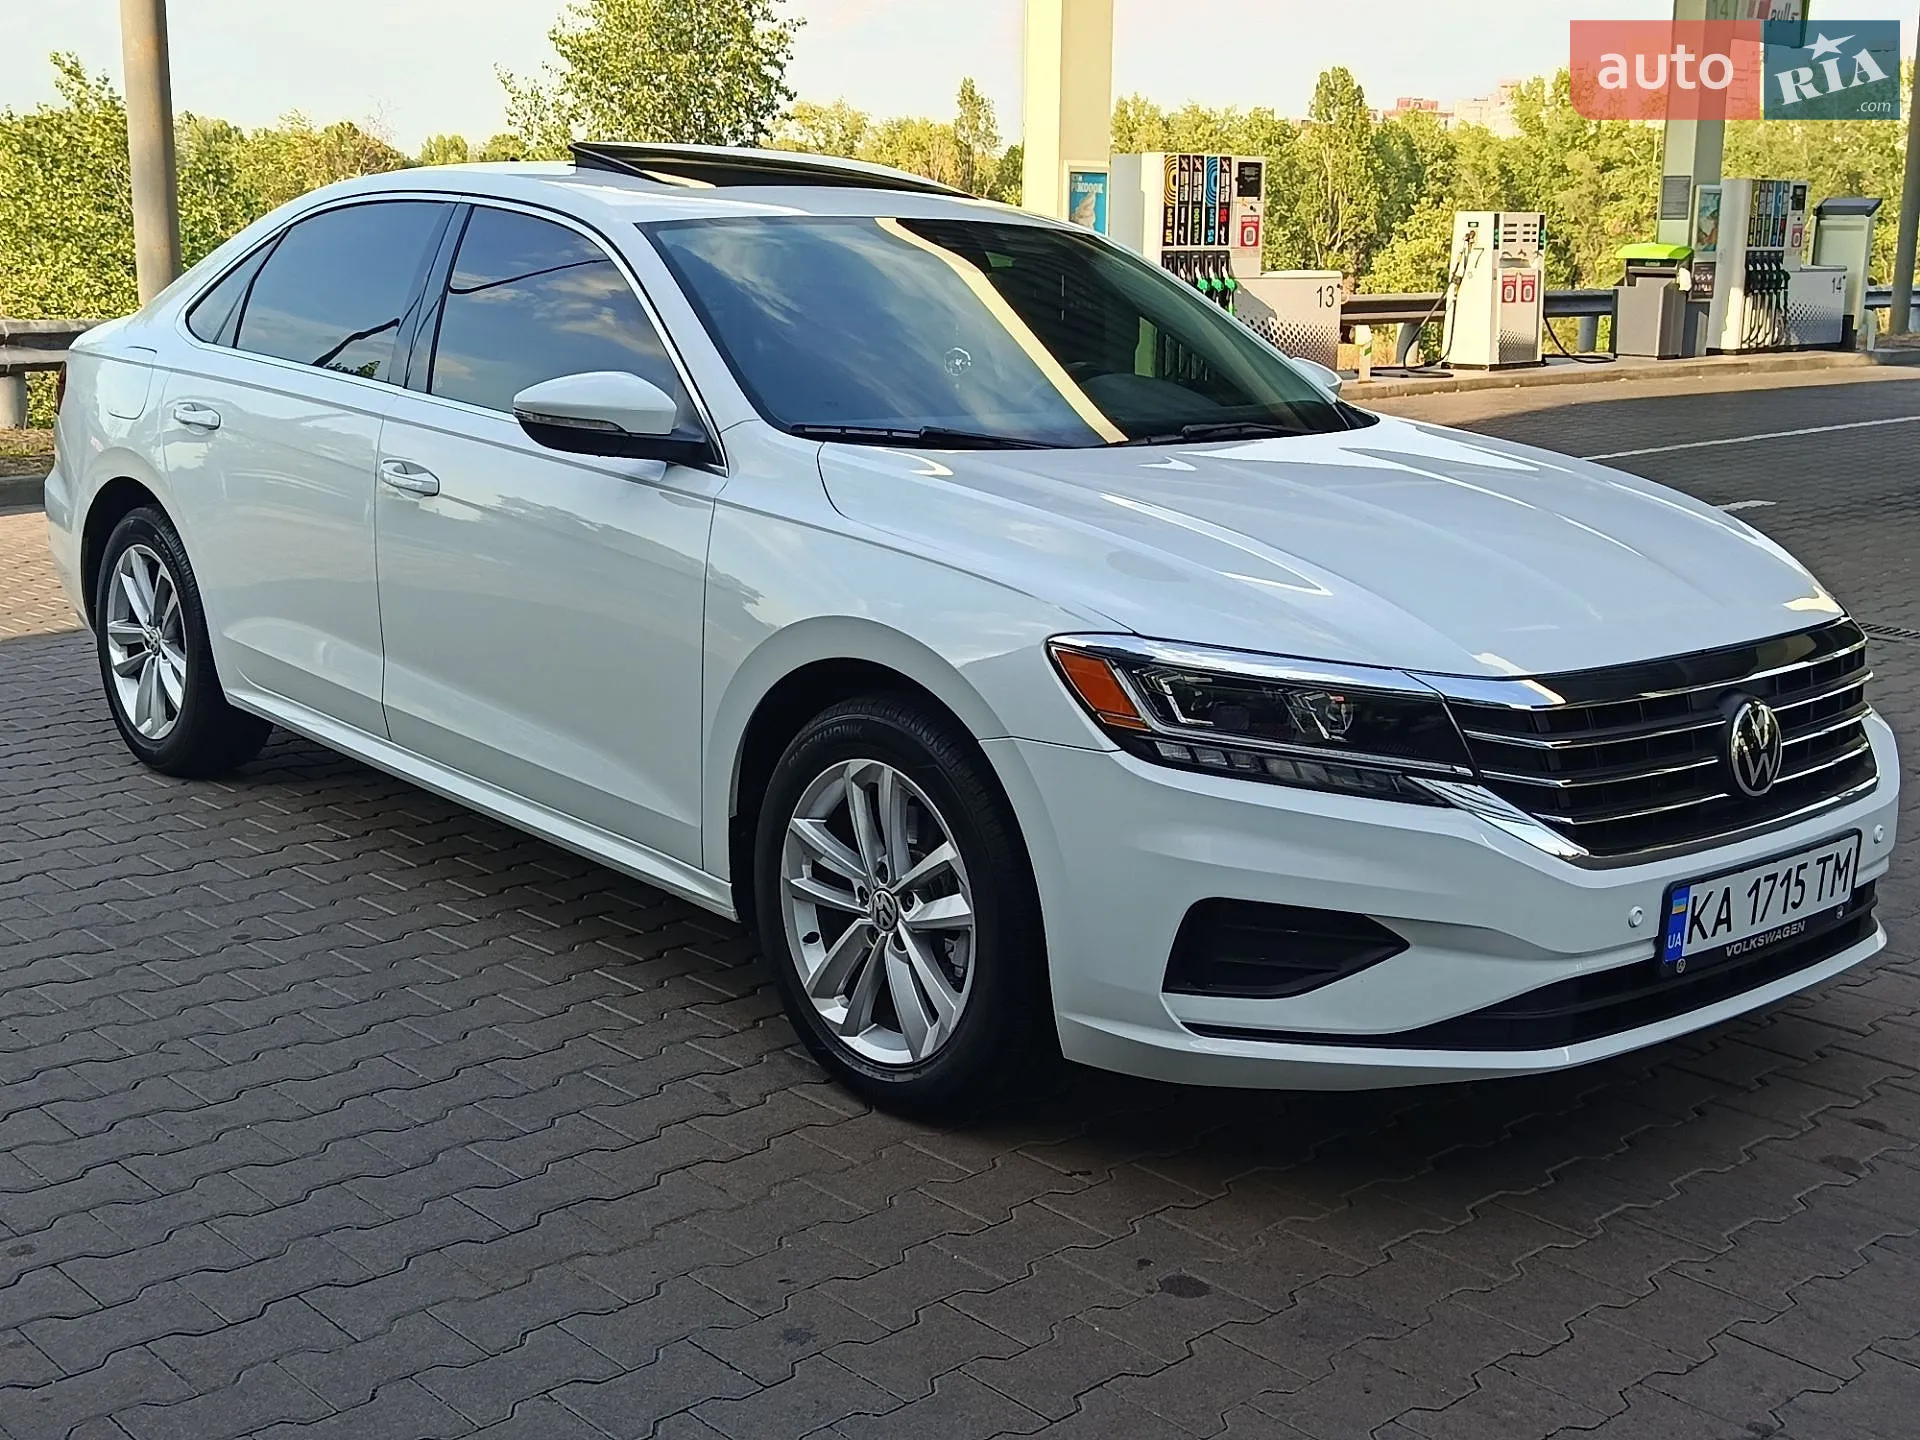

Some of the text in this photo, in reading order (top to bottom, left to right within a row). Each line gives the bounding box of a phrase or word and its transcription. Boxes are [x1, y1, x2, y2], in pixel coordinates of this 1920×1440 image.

[1768, 3, 1800, 27] pulls
[1473, 248, 1485, 268] 7
[1316, 285, 1336, 309] 13
[1687, 847, 1853, 944] KA 1715 TM
[1667, 932, 1682, 949] UA
[1726, 919, 1806, 957] VOLKSWAGEN
